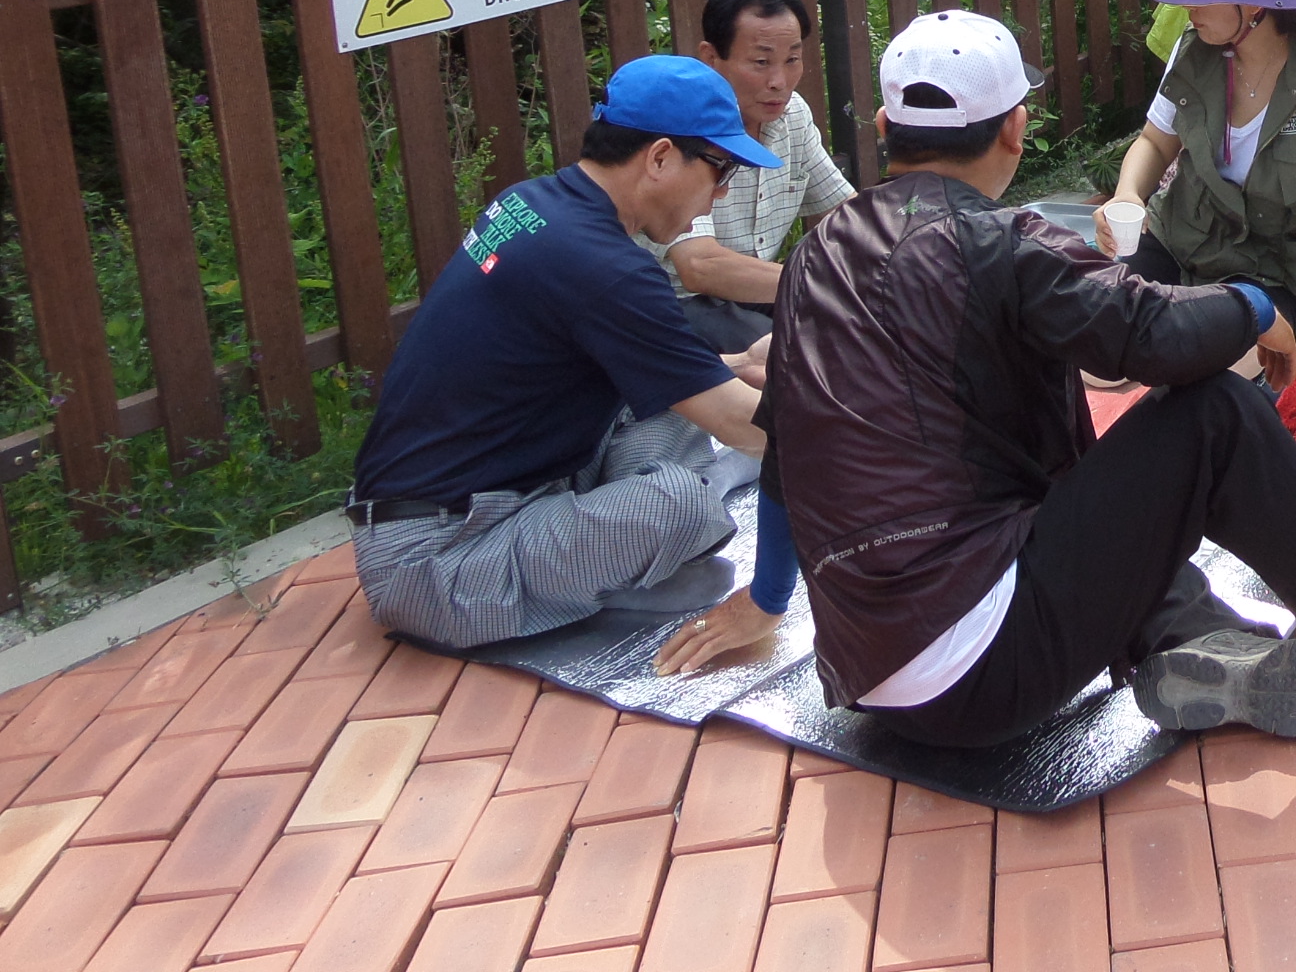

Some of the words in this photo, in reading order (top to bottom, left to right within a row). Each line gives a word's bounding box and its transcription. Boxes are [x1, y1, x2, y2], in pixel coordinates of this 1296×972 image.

[501, 192, 547, 234] EXPLORE
[480, 223, 506, 253] TALK
[858, 542, 869, 552] BY
